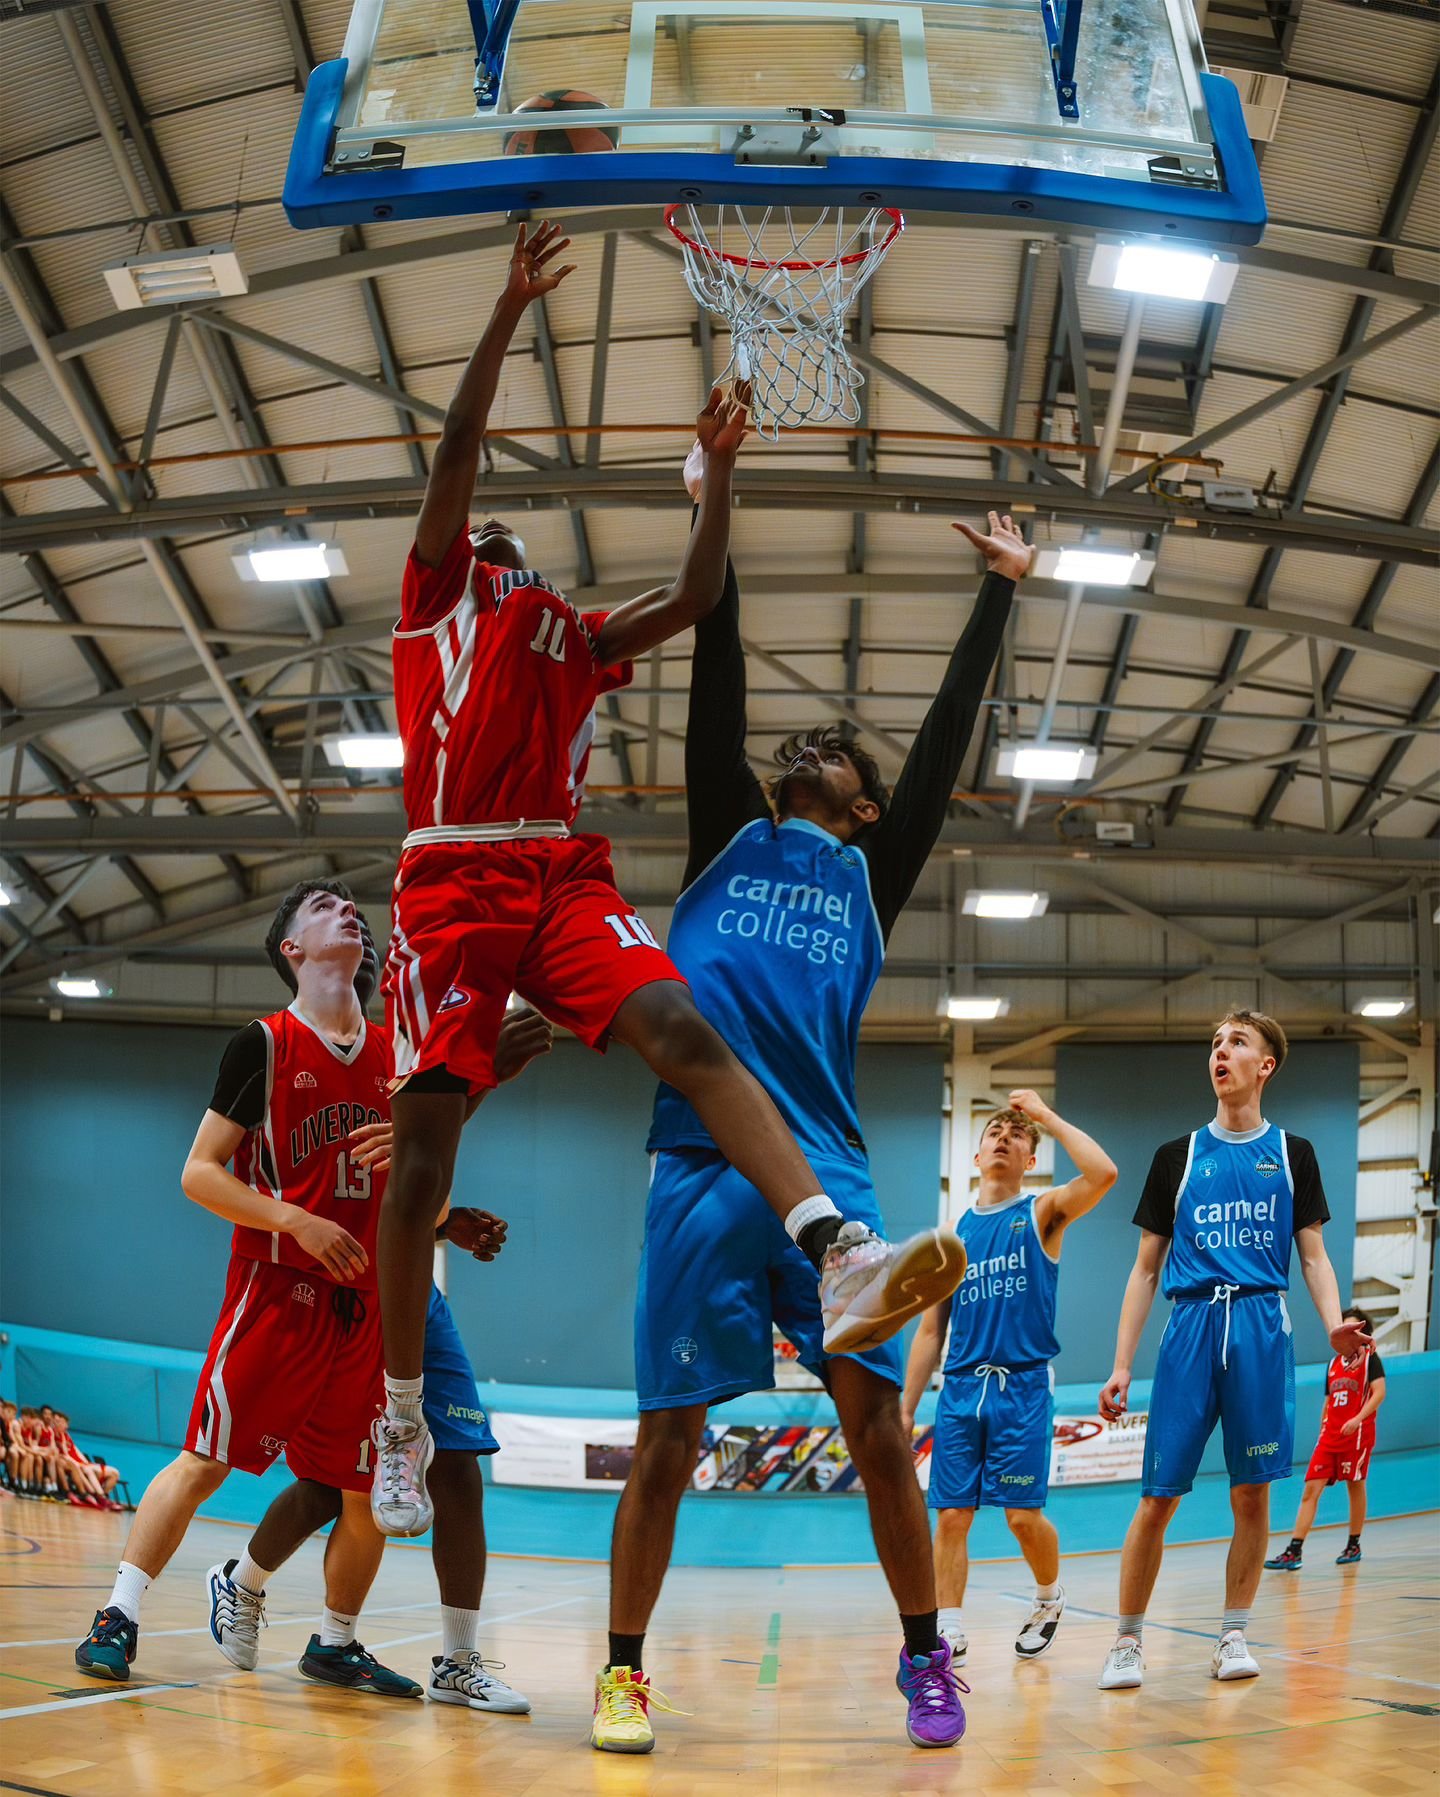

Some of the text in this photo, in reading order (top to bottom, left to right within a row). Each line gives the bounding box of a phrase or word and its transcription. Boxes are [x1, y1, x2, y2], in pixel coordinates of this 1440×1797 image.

[529, 607, 566, 663] 10
[727, 874, 853, 930] carmel
[604, 914, 662, 949] 10
[717, 907, 849, 965] college
[334, 1151, 372, 1200] 13
[1193, 1194, 1277, 1224] carmel
[1195, 1222, 1274, 1250] college
[960, 1245, 1027, 1282] armel
[960, 1275, 1028, 1306] college
[681, 1351, 691, 1362] 5
[1333, 1390, 1348, 1408] 75
[356, 1439, 377, 1474] 1
[1341, 1462, 1352, 1475] 75
